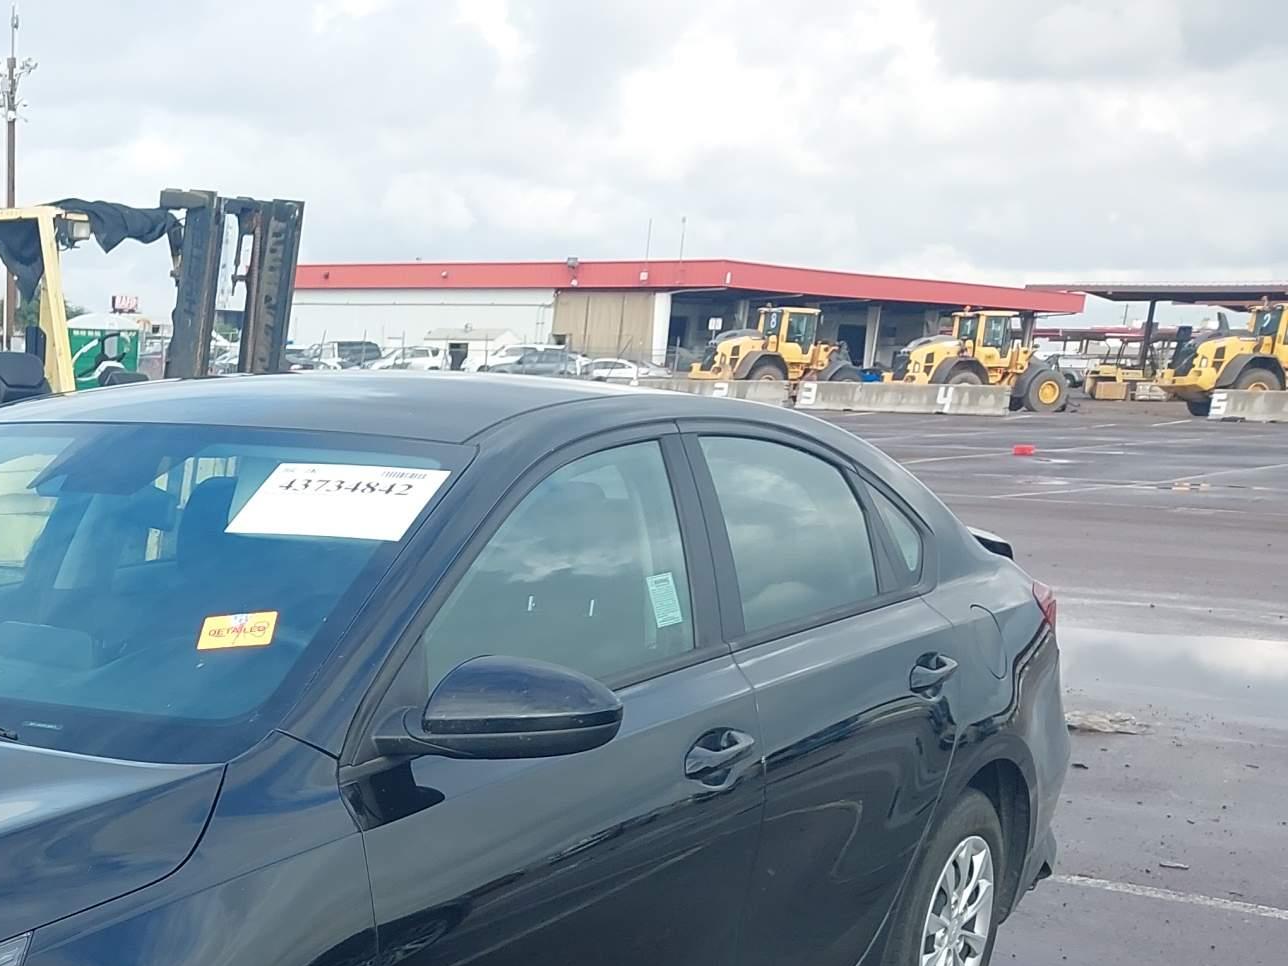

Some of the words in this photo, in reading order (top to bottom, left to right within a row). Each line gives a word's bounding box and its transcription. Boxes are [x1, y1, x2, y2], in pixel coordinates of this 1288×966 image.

[799, 383, 818, 405] 3
[937, 386, 955, 413] 4
[1207, 392, 1228, 420] 5
[279, 478, 414, 496] 43734842
